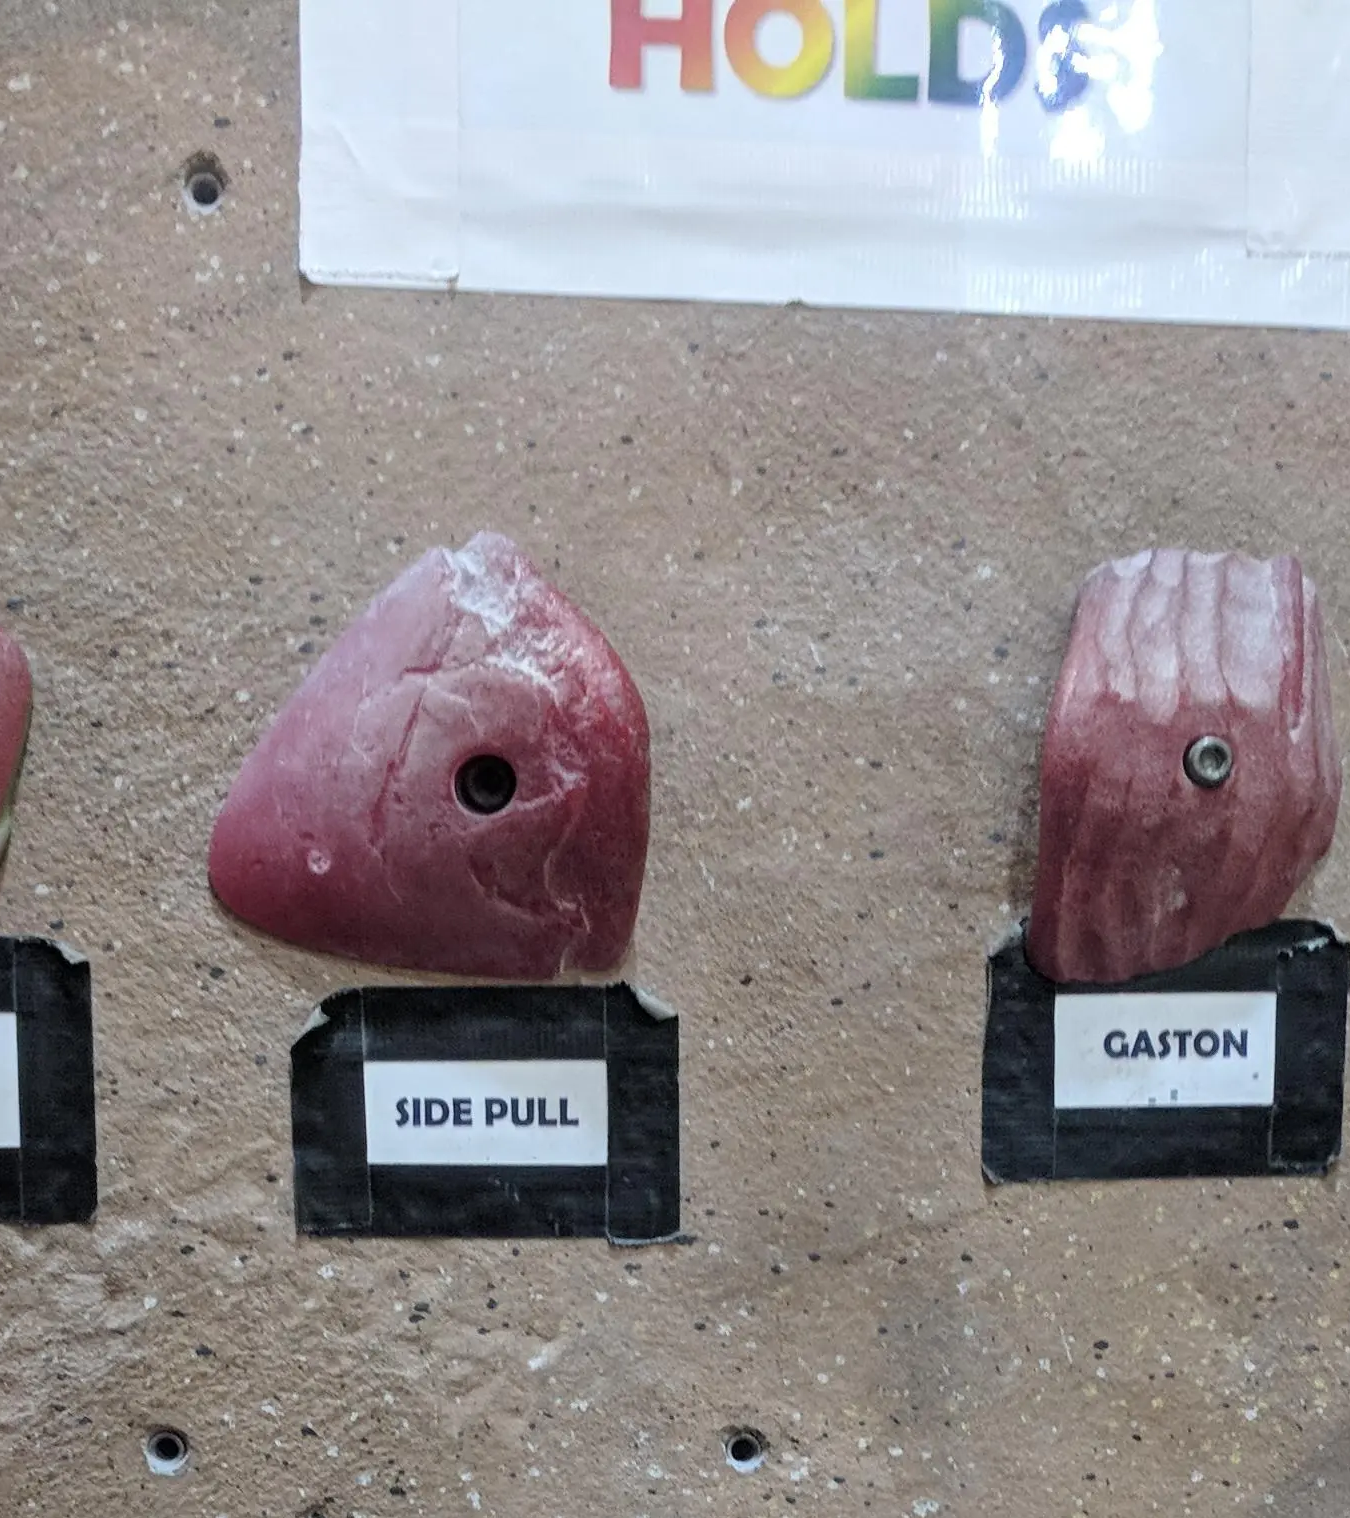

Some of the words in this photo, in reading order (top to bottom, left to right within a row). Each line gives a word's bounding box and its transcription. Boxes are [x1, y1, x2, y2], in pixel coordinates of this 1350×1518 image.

[1104, 1028, 1249, 1060] GASTON
[394, 1096, 474, 1128] SIDE
[484, 1097, 579, 1128] PULL
